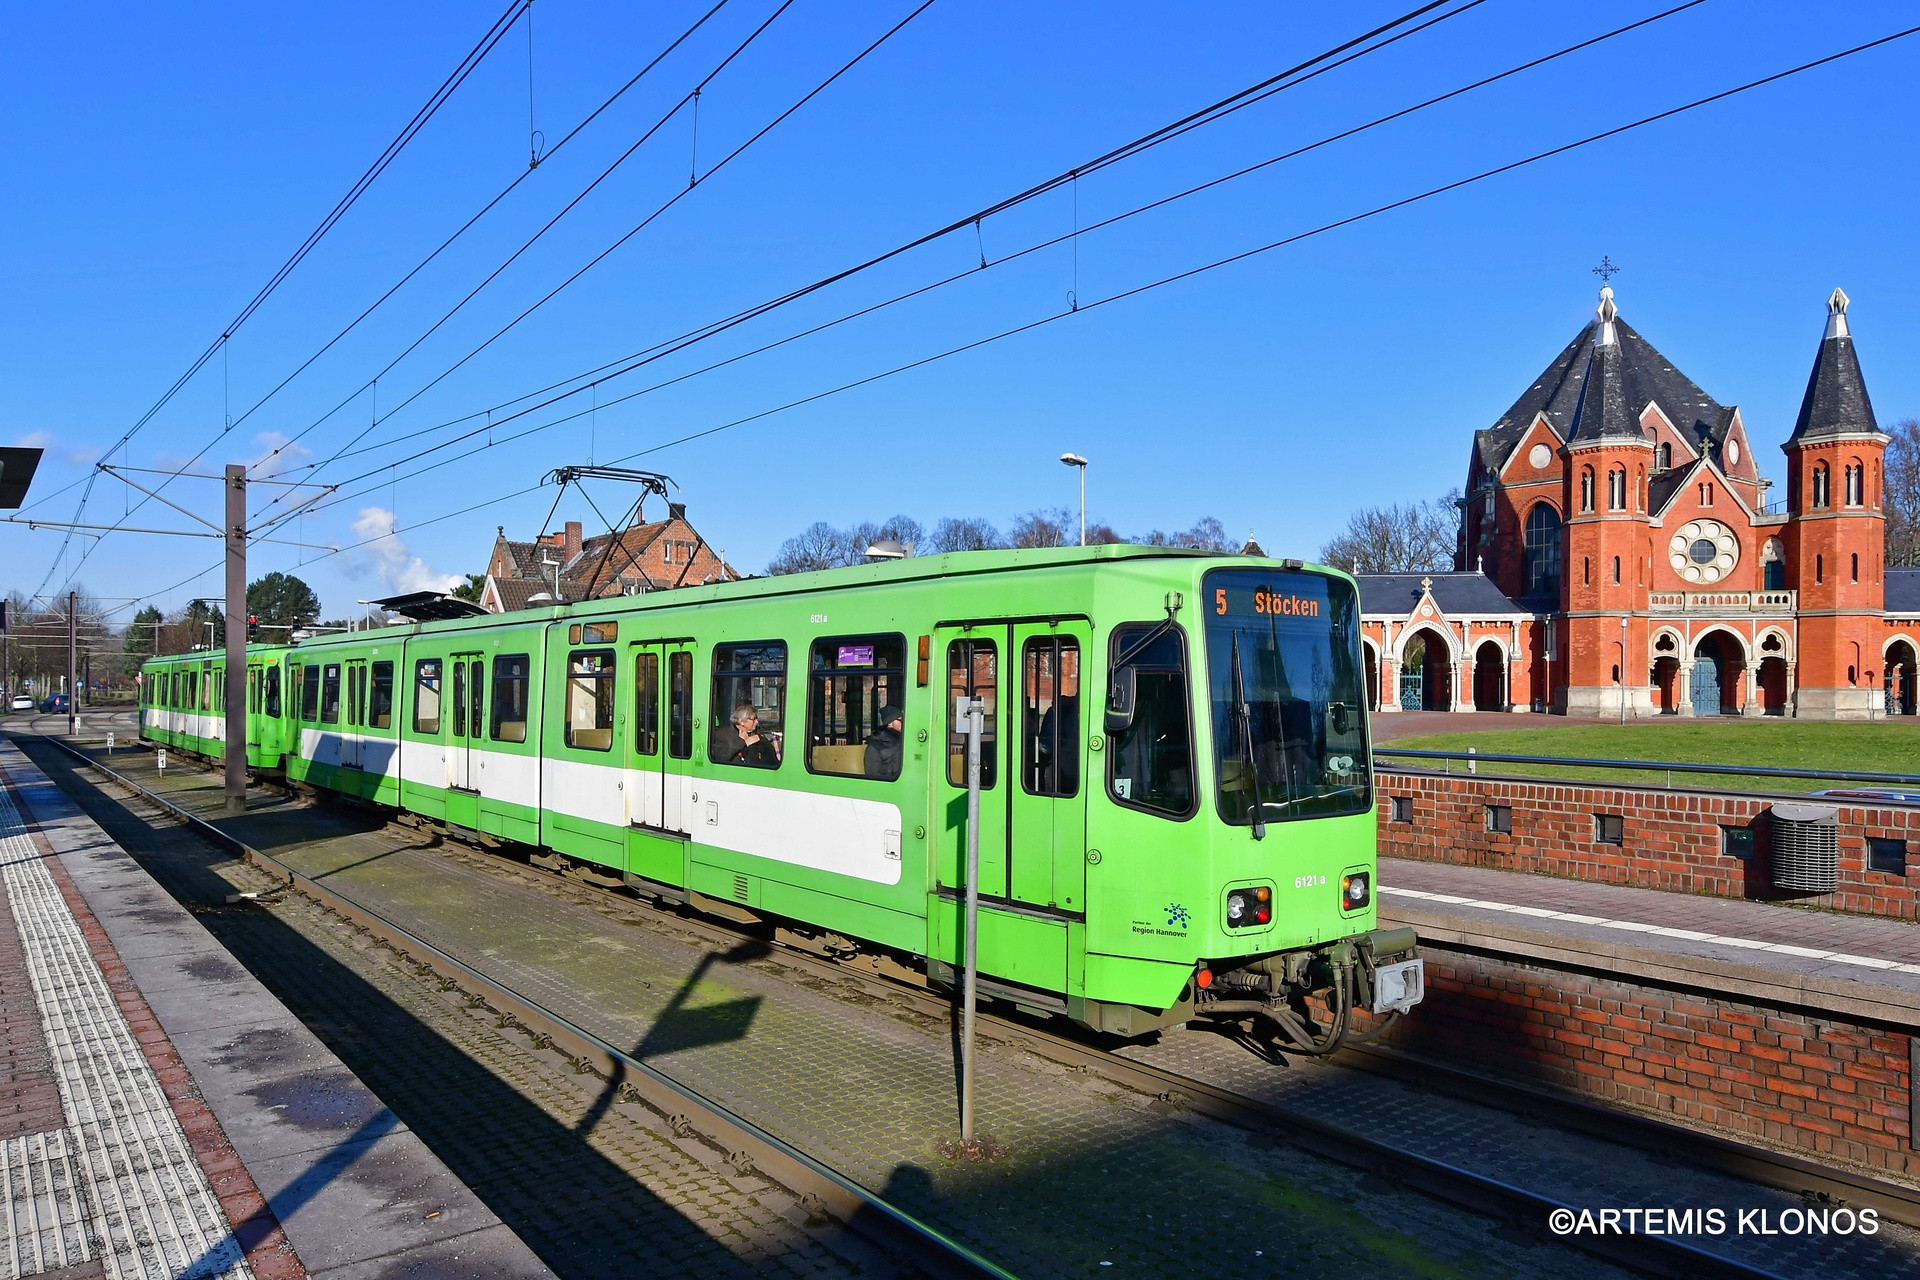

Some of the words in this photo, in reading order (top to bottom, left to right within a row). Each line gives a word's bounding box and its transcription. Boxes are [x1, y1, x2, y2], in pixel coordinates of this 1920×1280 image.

[1216, 589, 1227, 615] 5
[1255, 592, 1318, 617] Stöcken
[810, 614, 823, 623] 6121
[1118, 785, 1125, 796] 3
[1295, 874, 1317, 889] 6121
[1320, 875, 1326, 885] a
[1132, 926, 1155, 935] Region
[1156, 929, 1187, 938] Hannover
